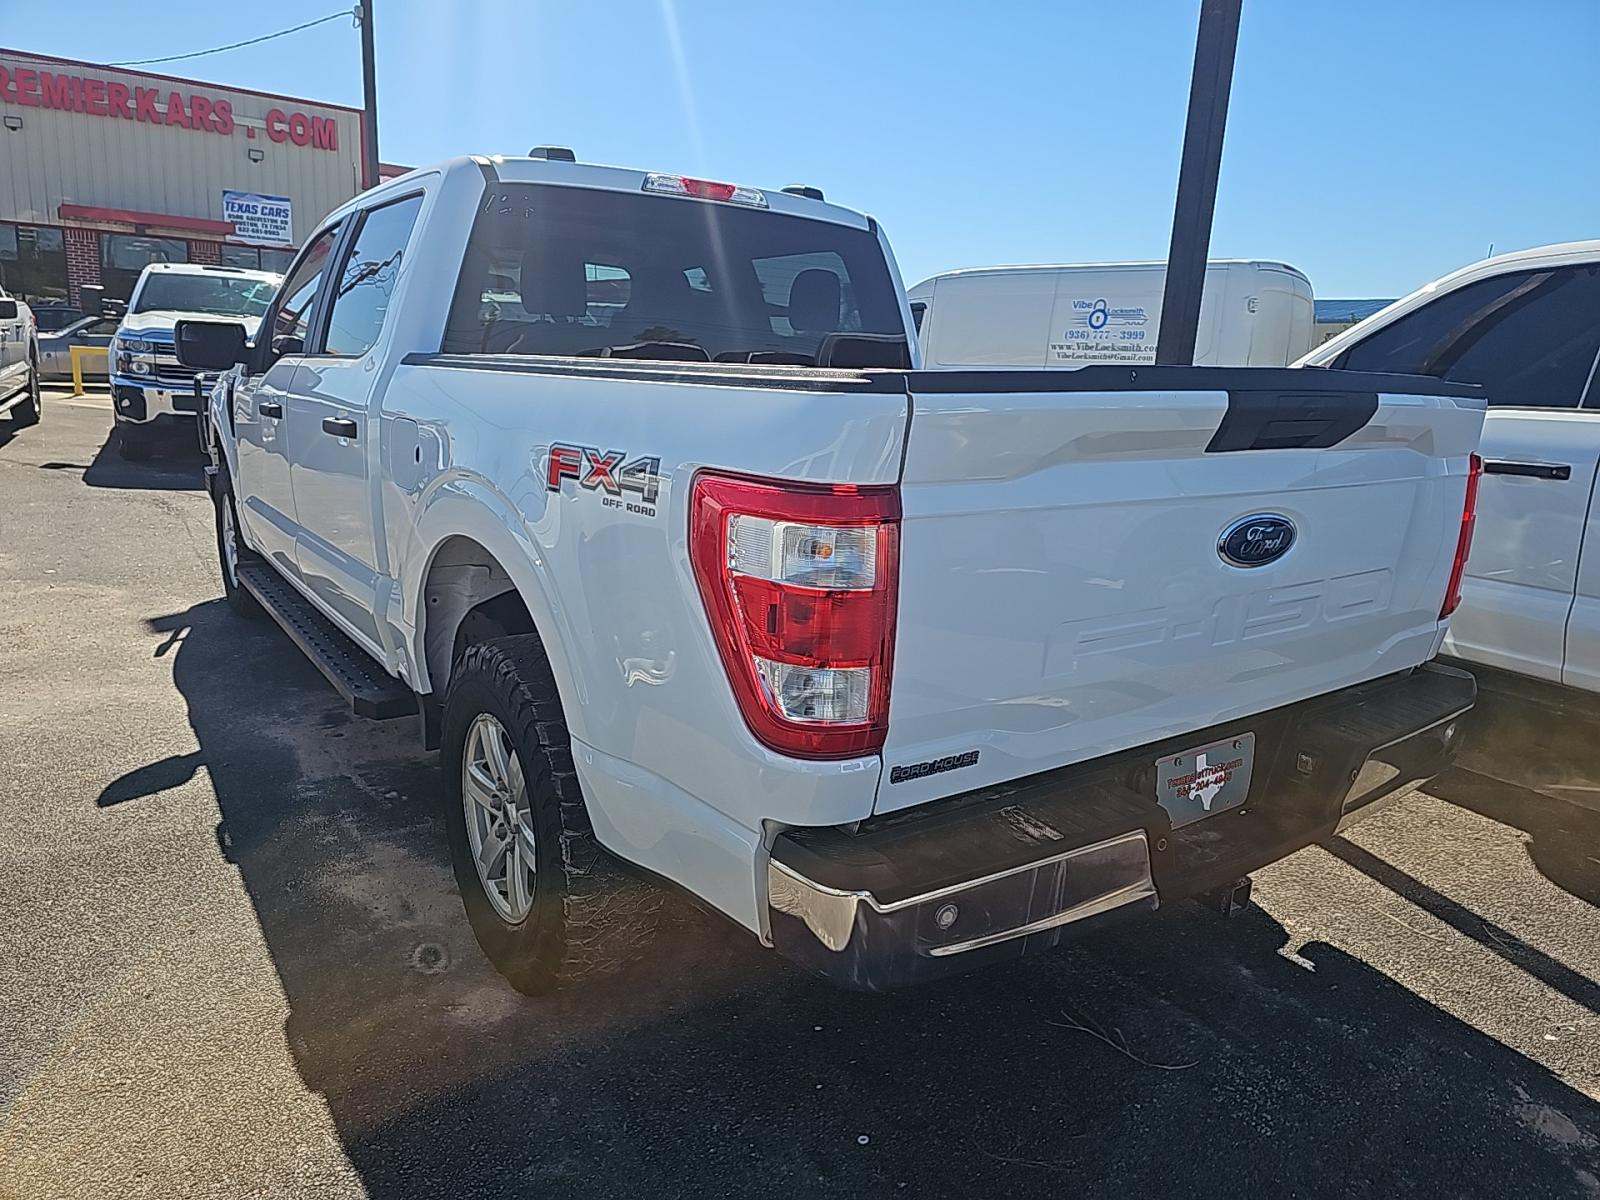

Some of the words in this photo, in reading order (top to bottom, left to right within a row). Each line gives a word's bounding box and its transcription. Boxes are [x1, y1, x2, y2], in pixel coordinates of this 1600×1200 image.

[225, 201, 258, 214] TEXAS
[261, 206, 289, 218] CARS
[1073, 300, 1093, 310] Vibe
[1107, 307, 1144, 315] Locksmith
[1064, 329, 1090, 341] (936)
[1092, 330, 1111, 340] 777
[1119, 330, 1145, 341] 3999
[546, 442, 661, 504] FX4
[602, 497, 624, 509] OFF
[626, 503, 656, 518] ROAD
[891, 764, 930, 780] FORD
[932, 751, 980, 771] HOUSE
